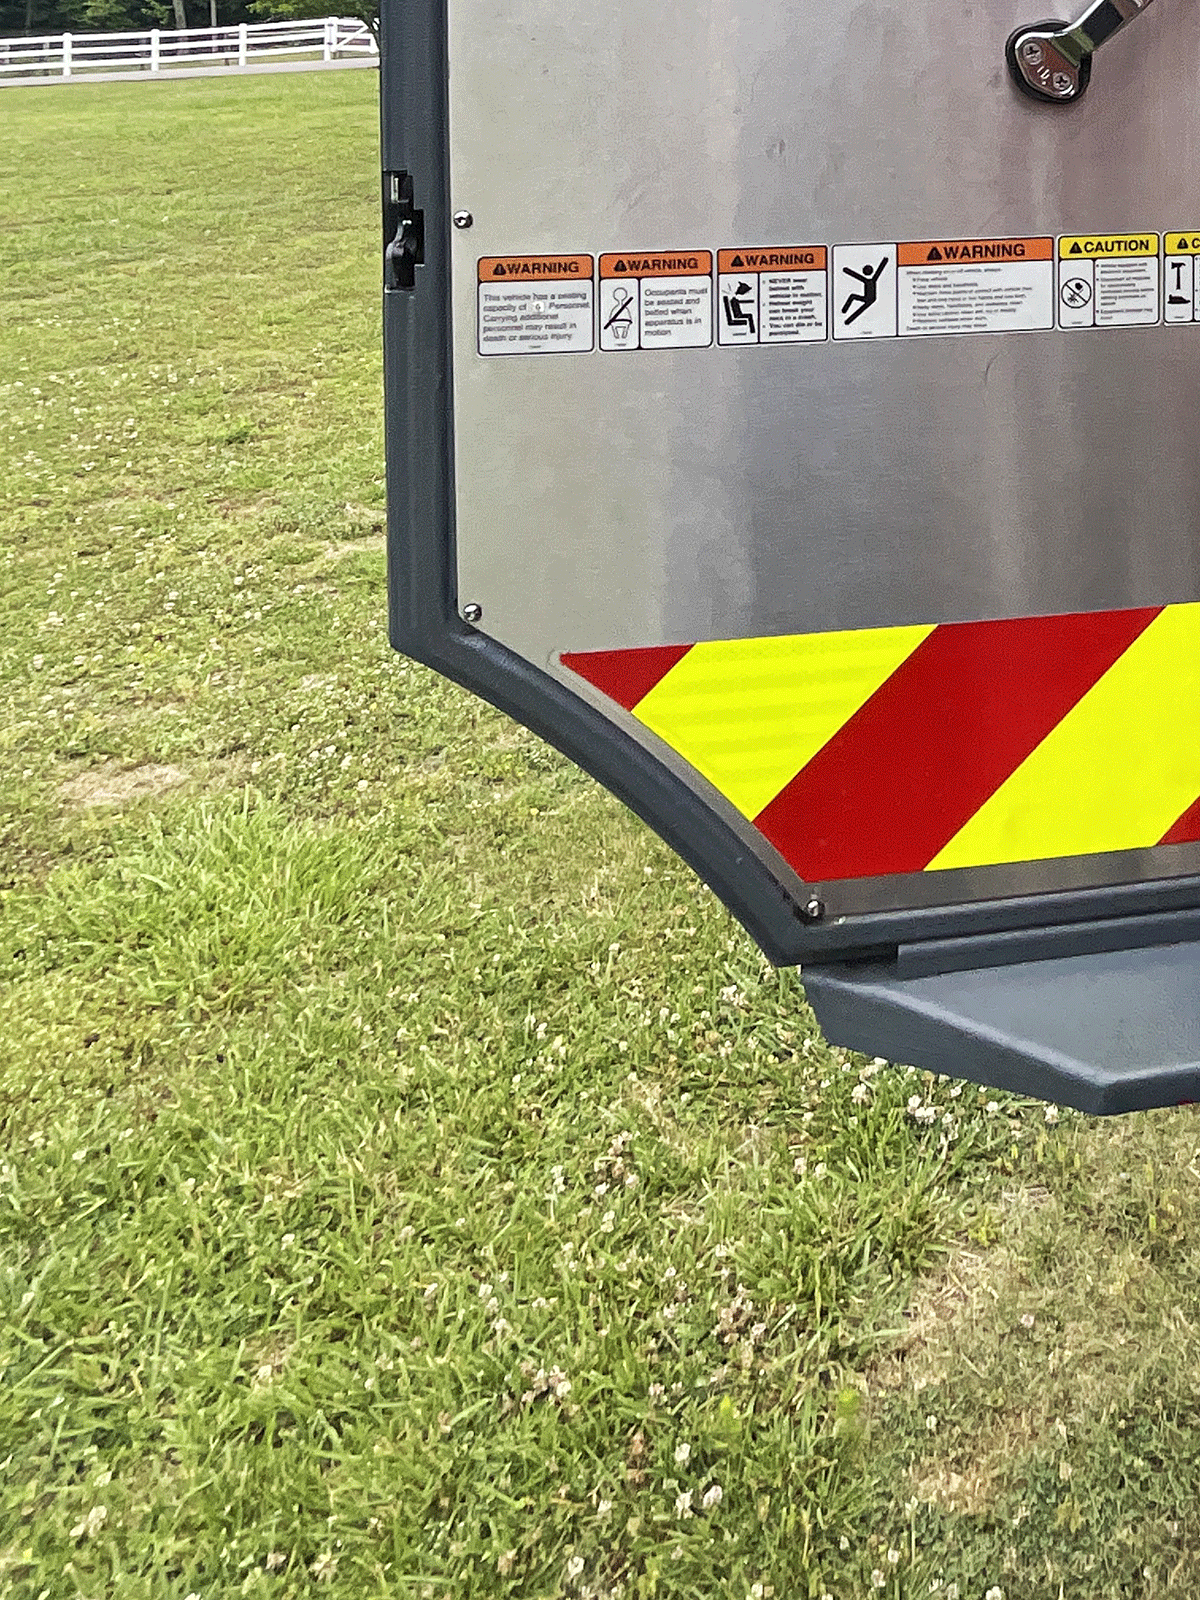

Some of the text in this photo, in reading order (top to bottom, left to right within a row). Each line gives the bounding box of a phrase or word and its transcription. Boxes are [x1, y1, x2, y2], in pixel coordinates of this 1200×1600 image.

[943, 243, 1026, 260] WARNING
[1084, 239, 1149, 253] CAUTION
[627, 258, 699, 271] WARNING
[745, 253, 814, 266] WARNING
[506, 261, 579, 274] WARNING
